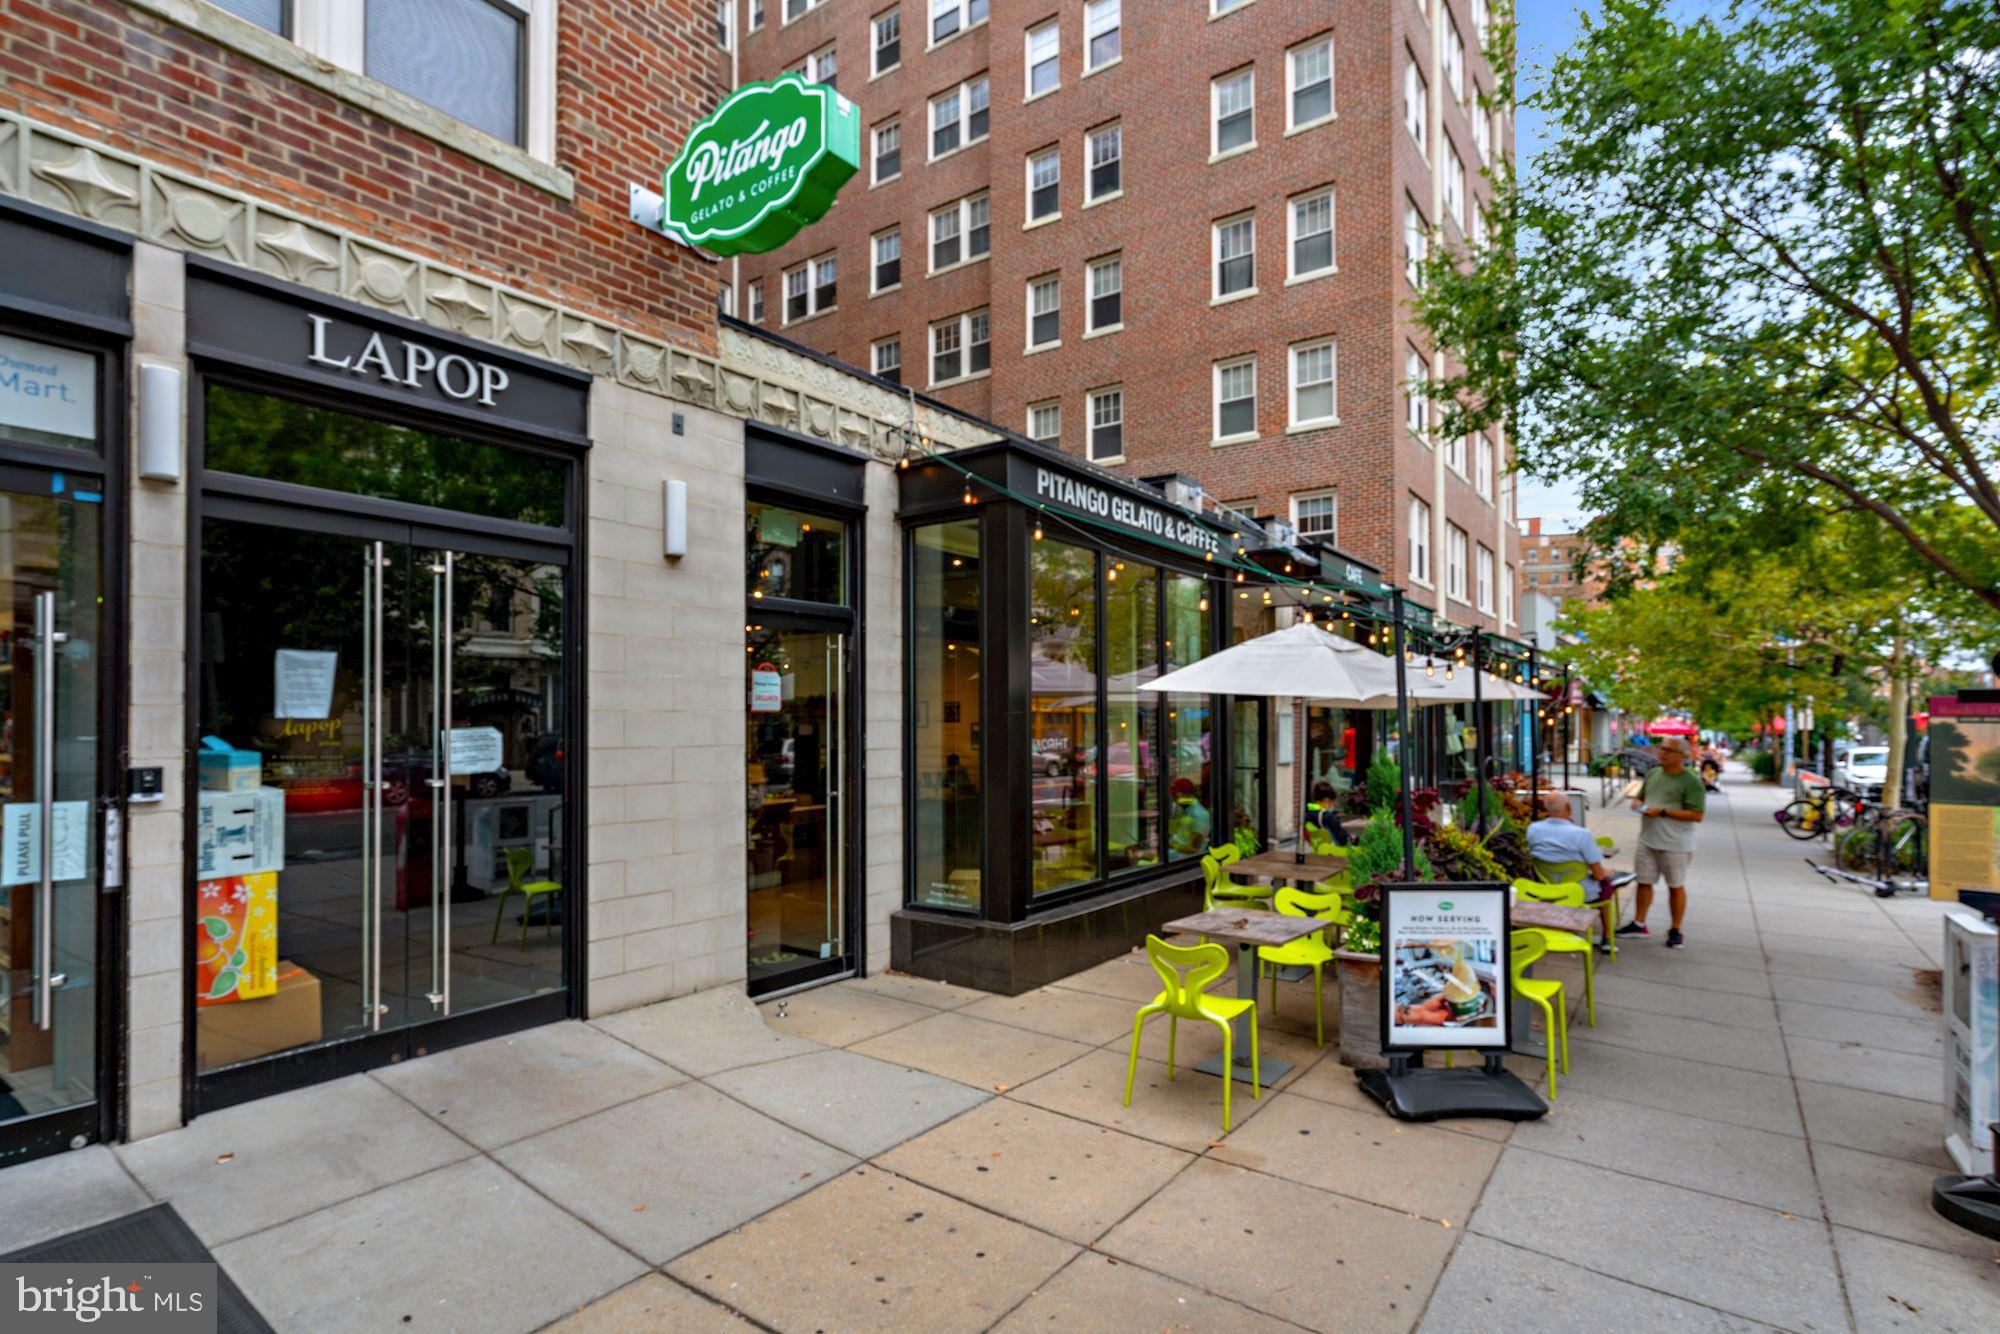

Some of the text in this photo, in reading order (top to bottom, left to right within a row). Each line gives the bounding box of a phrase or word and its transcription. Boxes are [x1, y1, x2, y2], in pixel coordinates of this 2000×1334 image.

[686, 116, 807, 201] Pitango
[691, 165, 796, 224] GELATO & COFFEE
[308, 313, 510, 406] LAPOP
[1037, 468, 1220, 554] PITANGO GELATO & COFFEE
[17, 811, 31, 877] PLEASE PULL
[1411, 915, 1482, 923] NOW SERVING
